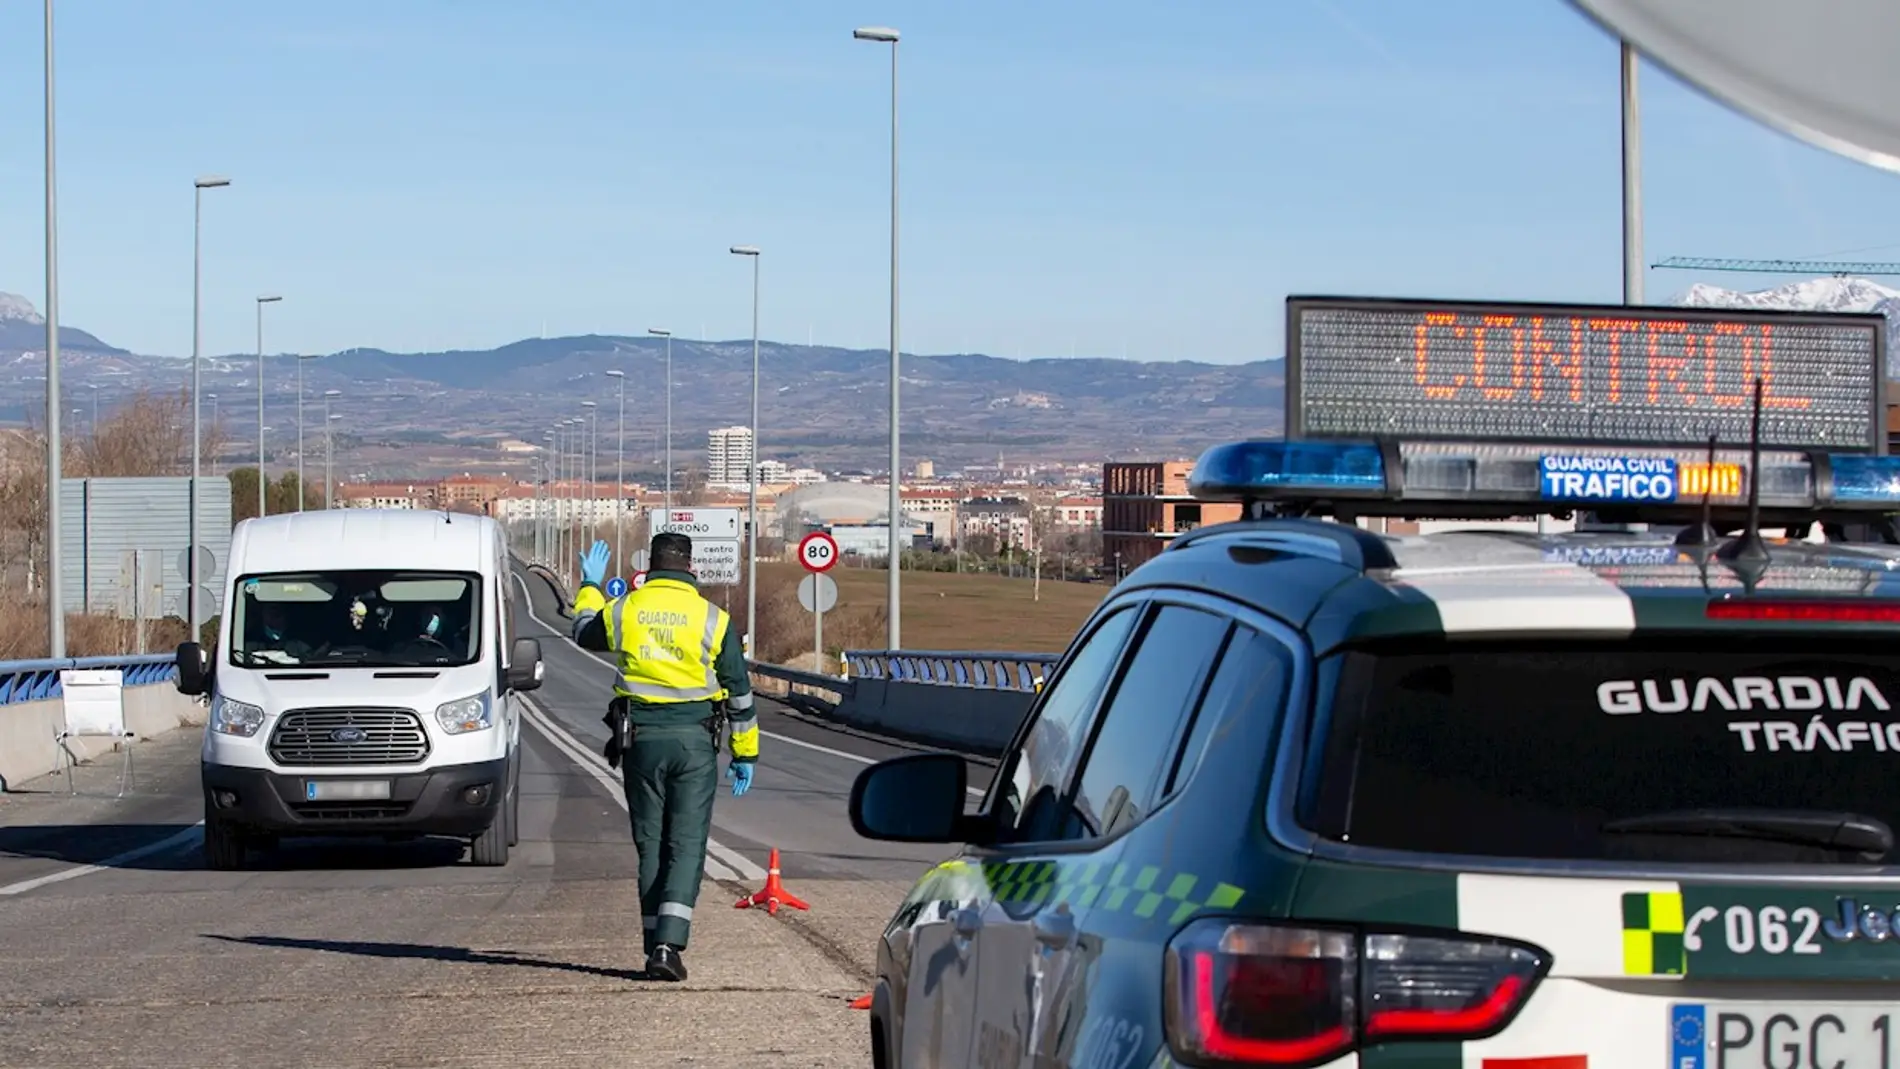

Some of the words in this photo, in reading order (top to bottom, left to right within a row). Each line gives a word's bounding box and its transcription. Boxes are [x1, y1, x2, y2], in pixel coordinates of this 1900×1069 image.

[1416, 312, 1812, 407] CONTROL
[1544, 456, 1626, 473] GUARDIA
[1627, 458, 1673, 474] CIVIL
[1545, 472, 1673, 499] TRAFICO
[693, 556, 734, 565] tenciario
[807, 545, 829, 559] 80
[700, 569, 734, 579] SORIA
[637, 610, 688, 626] GUARDIA
[1597, 676, 1891, 715] GUARDIA
[1724, 905, 1822, 954] 062
[1717, 1012, 1846, 1069] PGC
